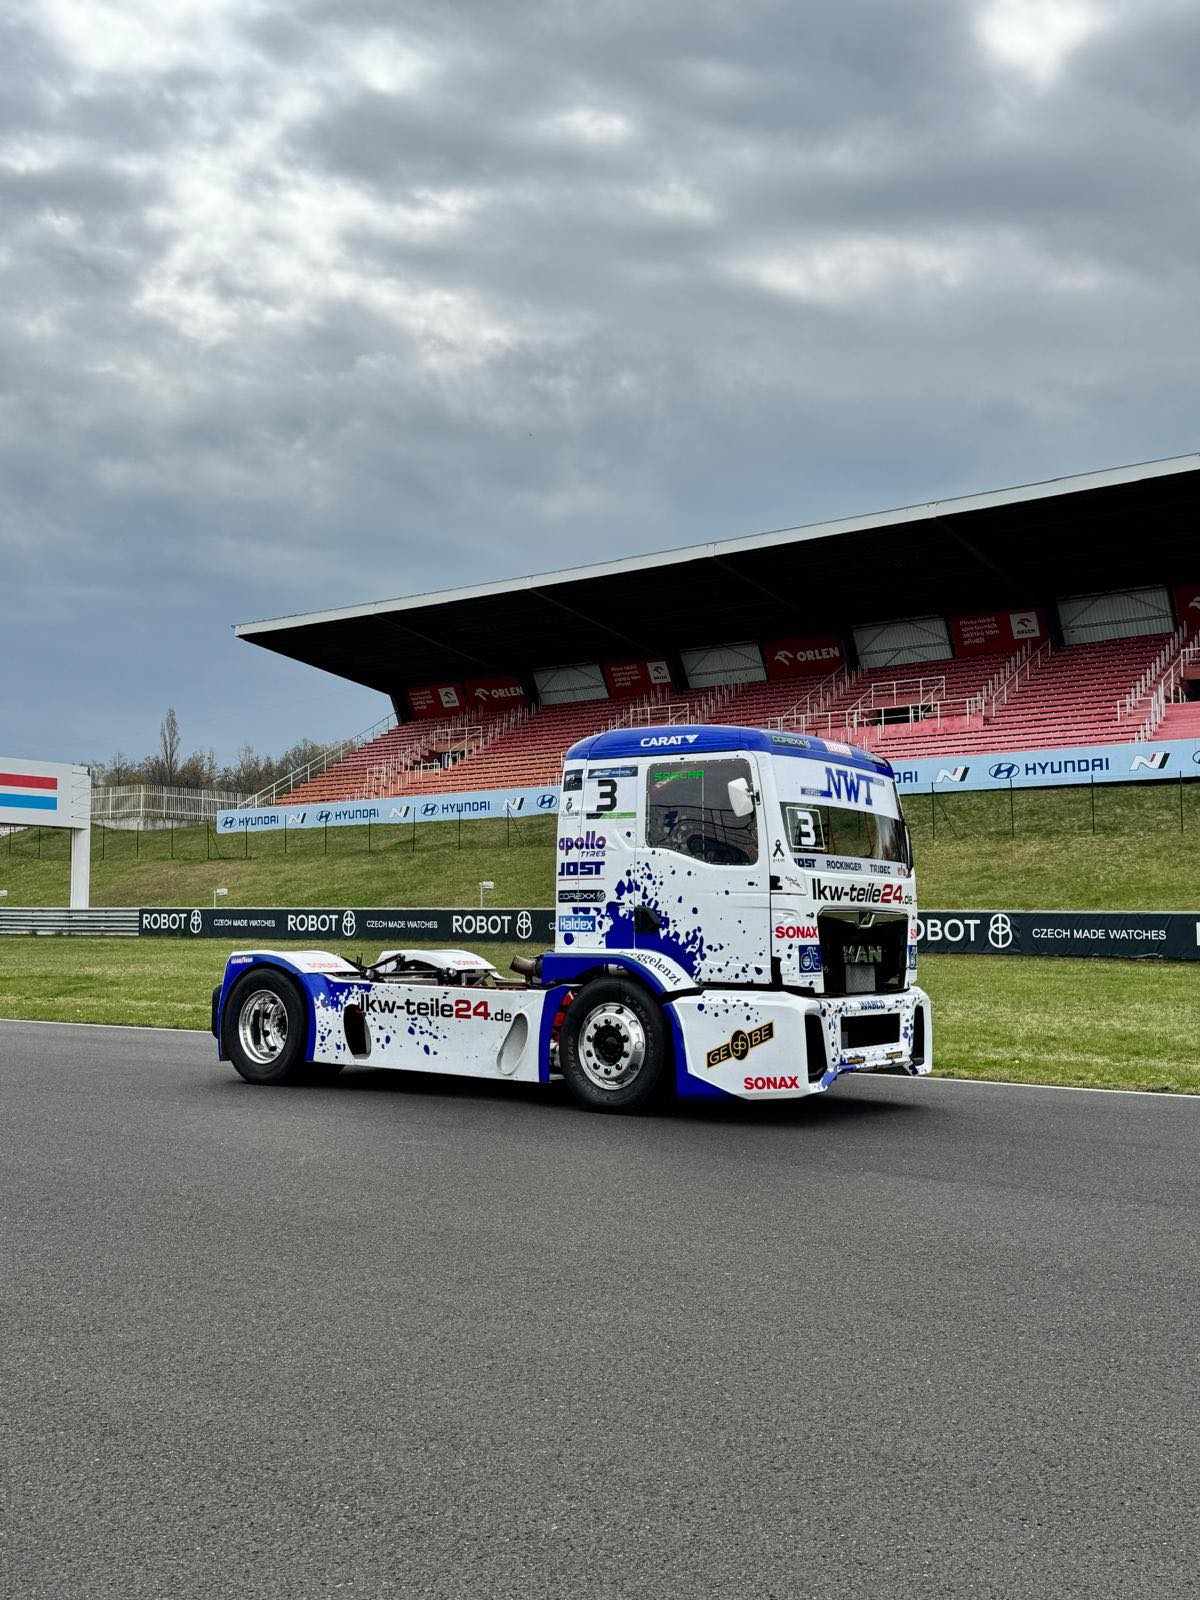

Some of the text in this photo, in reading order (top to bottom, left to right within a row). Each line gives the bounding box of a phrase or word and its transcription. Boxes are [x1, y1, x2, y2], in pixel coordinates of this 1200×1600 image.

[796, 646, 840, 662] ORLEN
[491, 686, 524, 699] ORLEN
[640, 735, 685, 747] CARAT
[1025, 757, 1110, 776] HYUNDAI
[825, 767, 873, 805] NWT
[596, 779, 617, 812] 3
[335, 808, 380, 820] HYUNDAI
[441, 801, 490, 813] HYUNDAI
[238, 815, 279, 826] HYUNDAI
[797, 811, 817, 846] 3
[559, 831, 606, 856] apollo
[558, 861, 605, 876] JOST
[826, 860, 862, 871] ROCKINGER
[870, 863, 891, 874] TRIDEC
[812, 878, 912, 905] lkw-teile24.de
[142, 913, 187, 930] ROBOT
[213, 919, 276, 928] CZECH MADE WATCHES
[287, 914, 339, 932] ROBOT
[366, 920, 438, 929] CZECH MADE WATCHES
[452, 915, 512, 934] ROBOT
[560, 917, 594, 931] Haldex
[775, 926, 818, 939] SONAX
[917, 919, 981, 941] BOT
[1032, 928, 1167, 940] CZECH MADE WATCHES
[843, 945, 882, 963] MAN
[360, 994, 512, 1023] lkw-teile24.de
[860, 1000, 886, 1010] WABCO
[744, 1075, 800, 1090] SONAX
